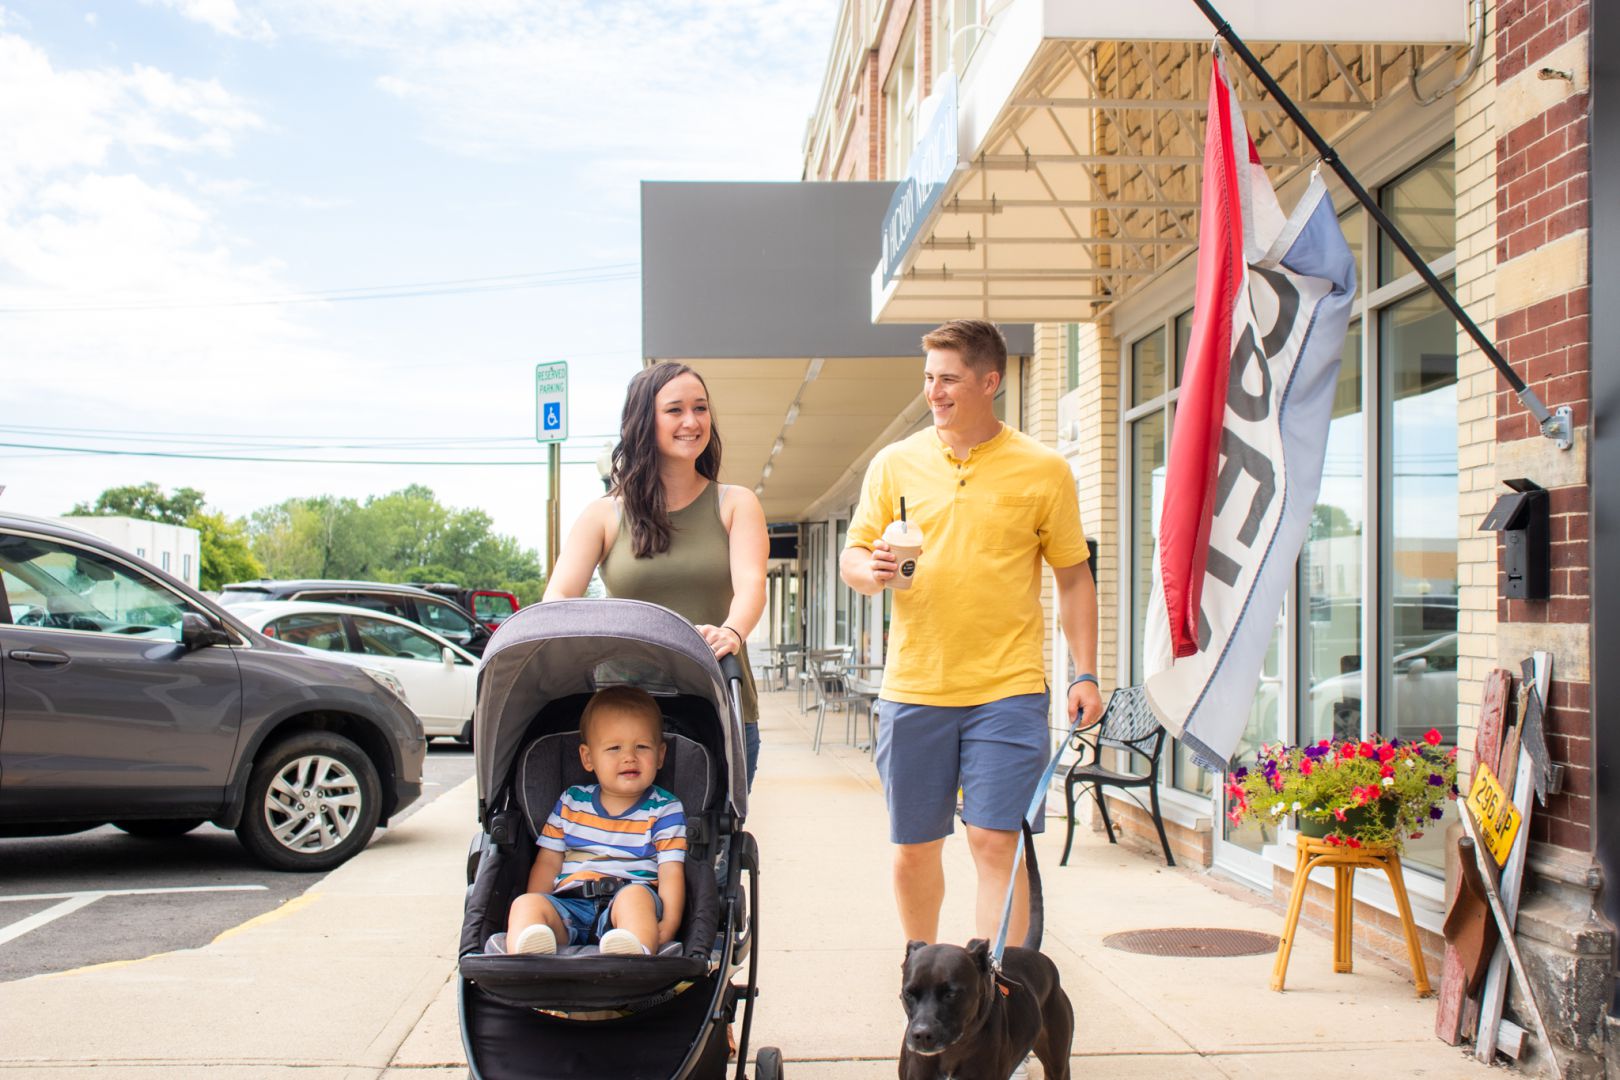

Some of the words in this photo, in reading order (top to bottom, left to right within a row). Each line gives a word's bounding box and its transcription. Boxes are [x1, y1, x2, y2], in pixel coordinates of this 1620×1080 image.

[537, 368, 566, 381] RESERVED
[539, 382, 564, 393] PARKING
[1475, 776, 1498, 820] 296
